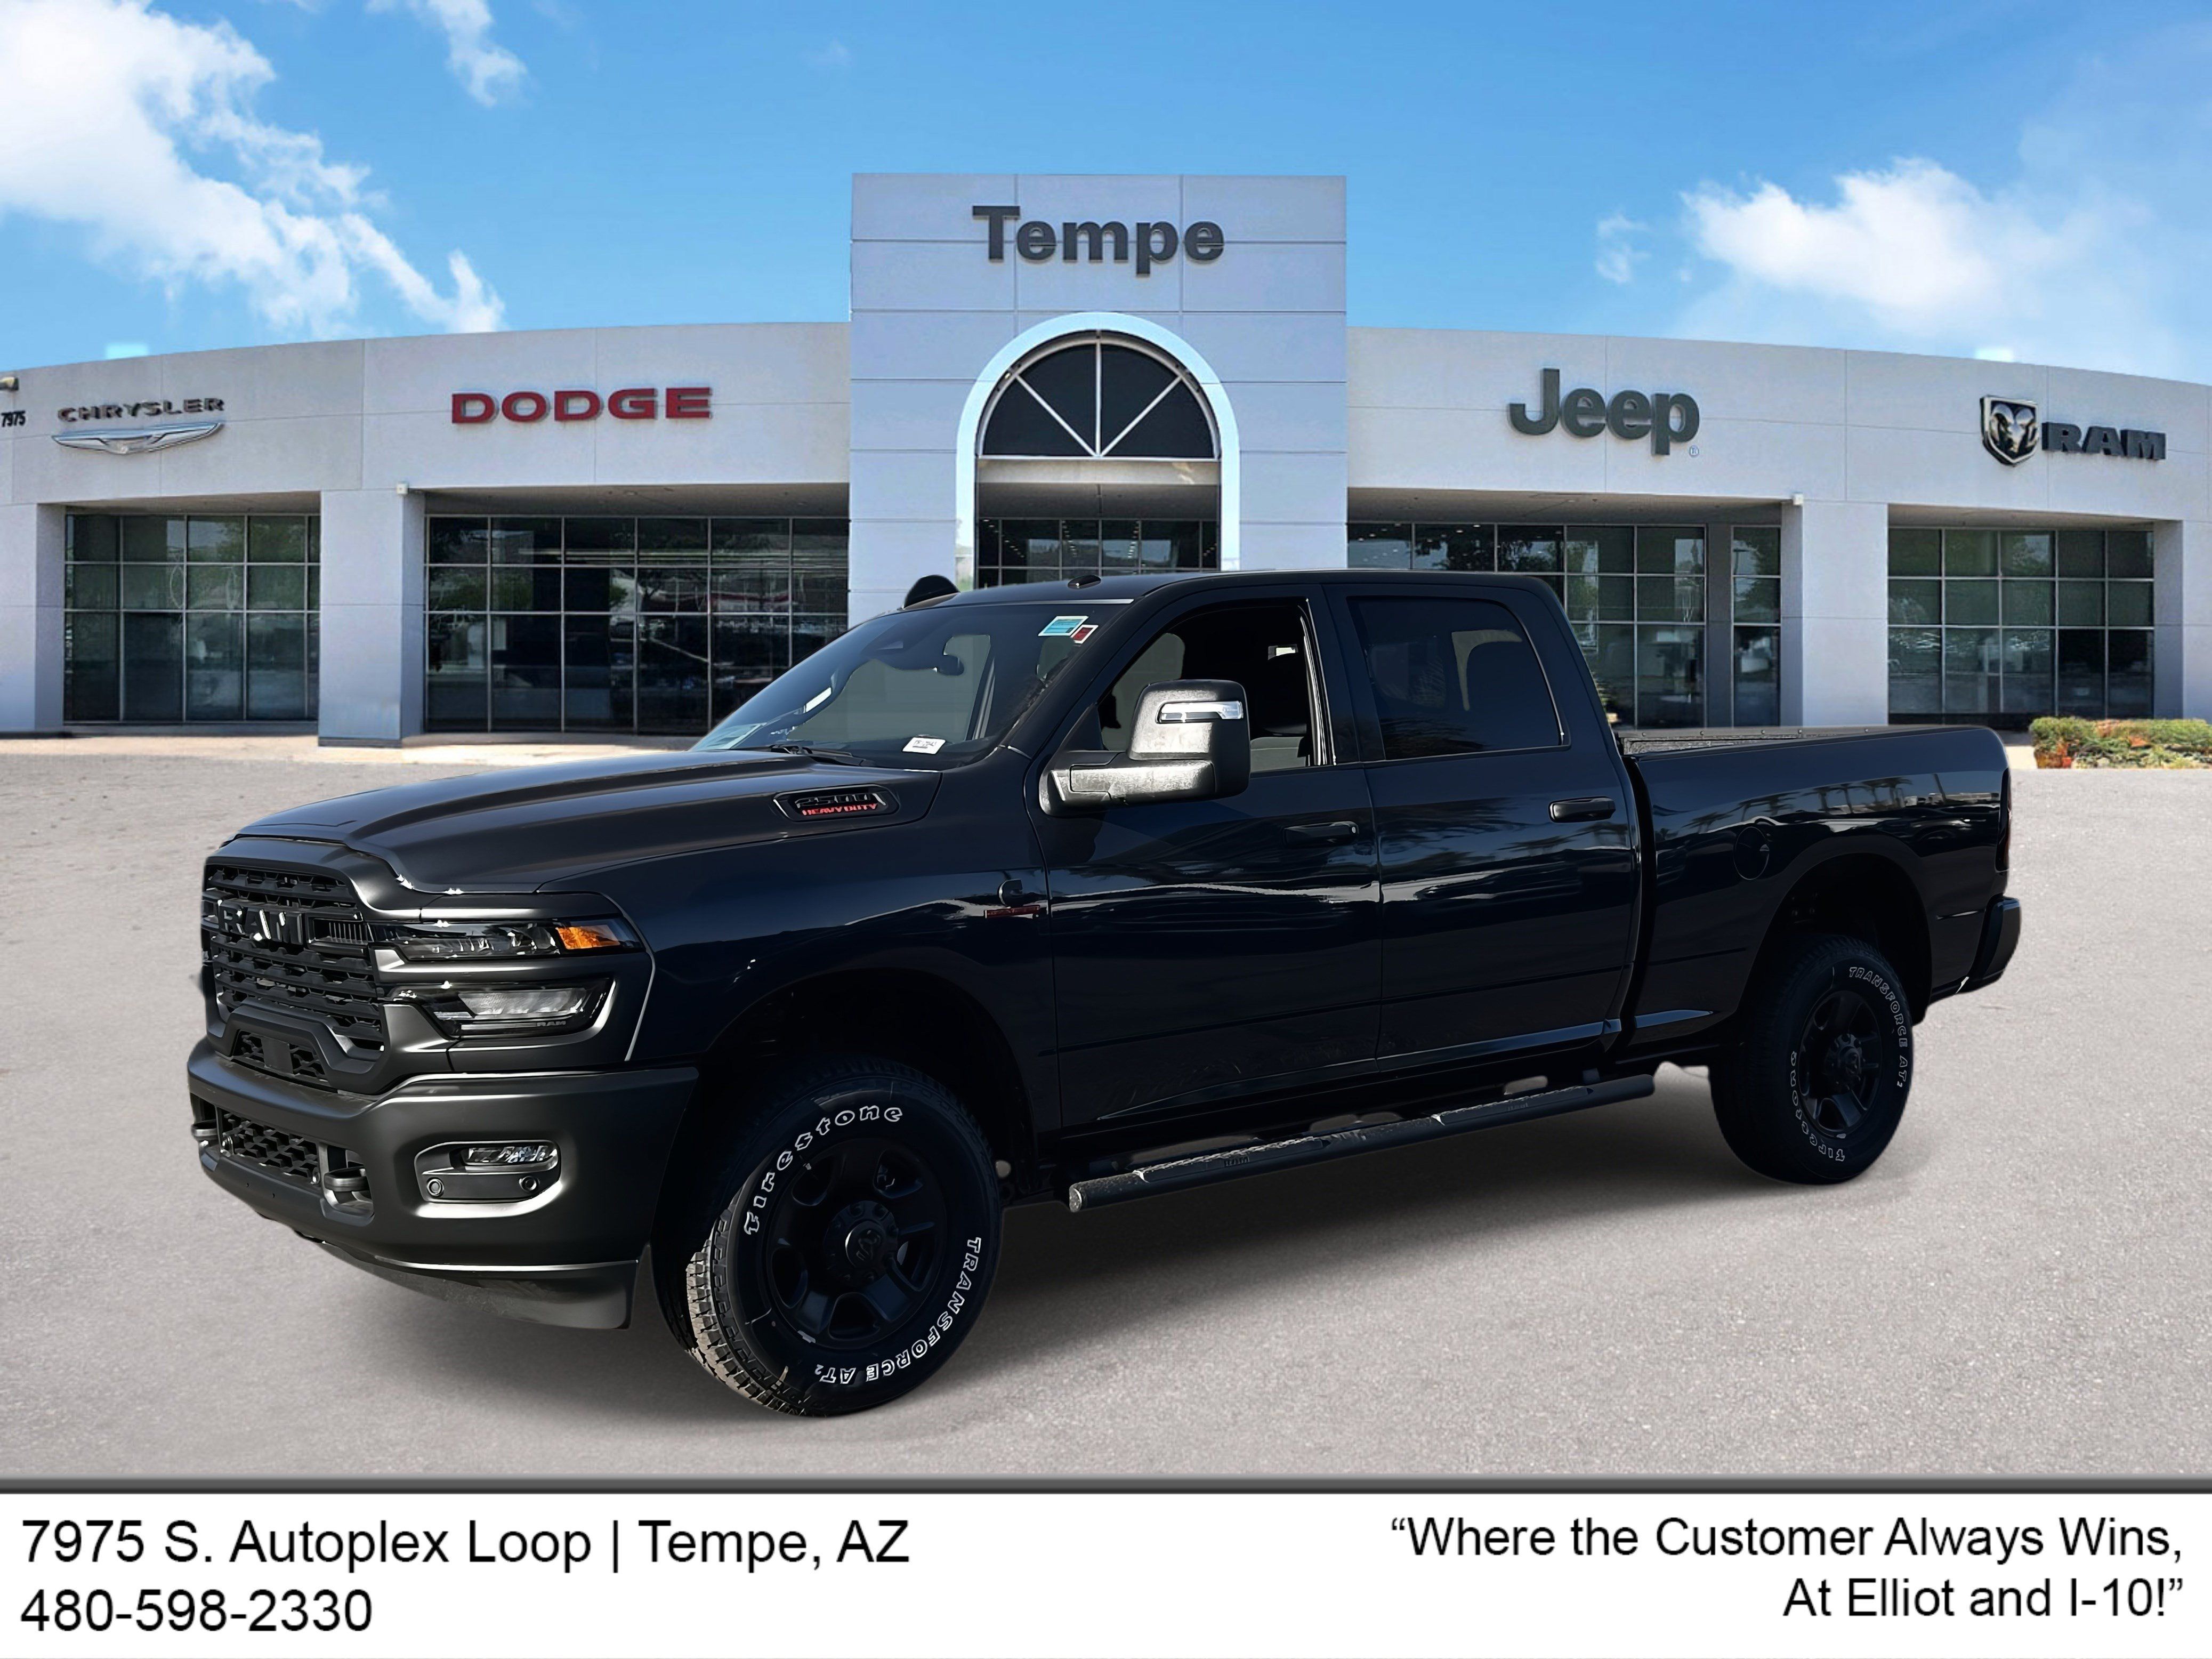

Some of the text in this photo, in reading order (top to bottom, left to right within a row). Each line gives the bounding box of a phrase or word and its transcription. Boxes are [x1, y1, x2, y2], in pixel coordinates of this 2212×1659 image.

[972, 205, 1225, 276] Tempe
[1, 410, 26, 427] 7975
[58, 397, 225, 422] CHRYSLER
[451, 387, 712, 423] DODGE
[1507, 368, 1699, 456] Jeep
[2041, 421, 2166, 461] RAM
[802, 803, 878, 816] HEAVY DUTY
[218, 904, 304, 946] RAM
[1848, 966, 1908, 1048] TRANSFORCE
[865, 1236, 982, 1384] TRANSFORCE
